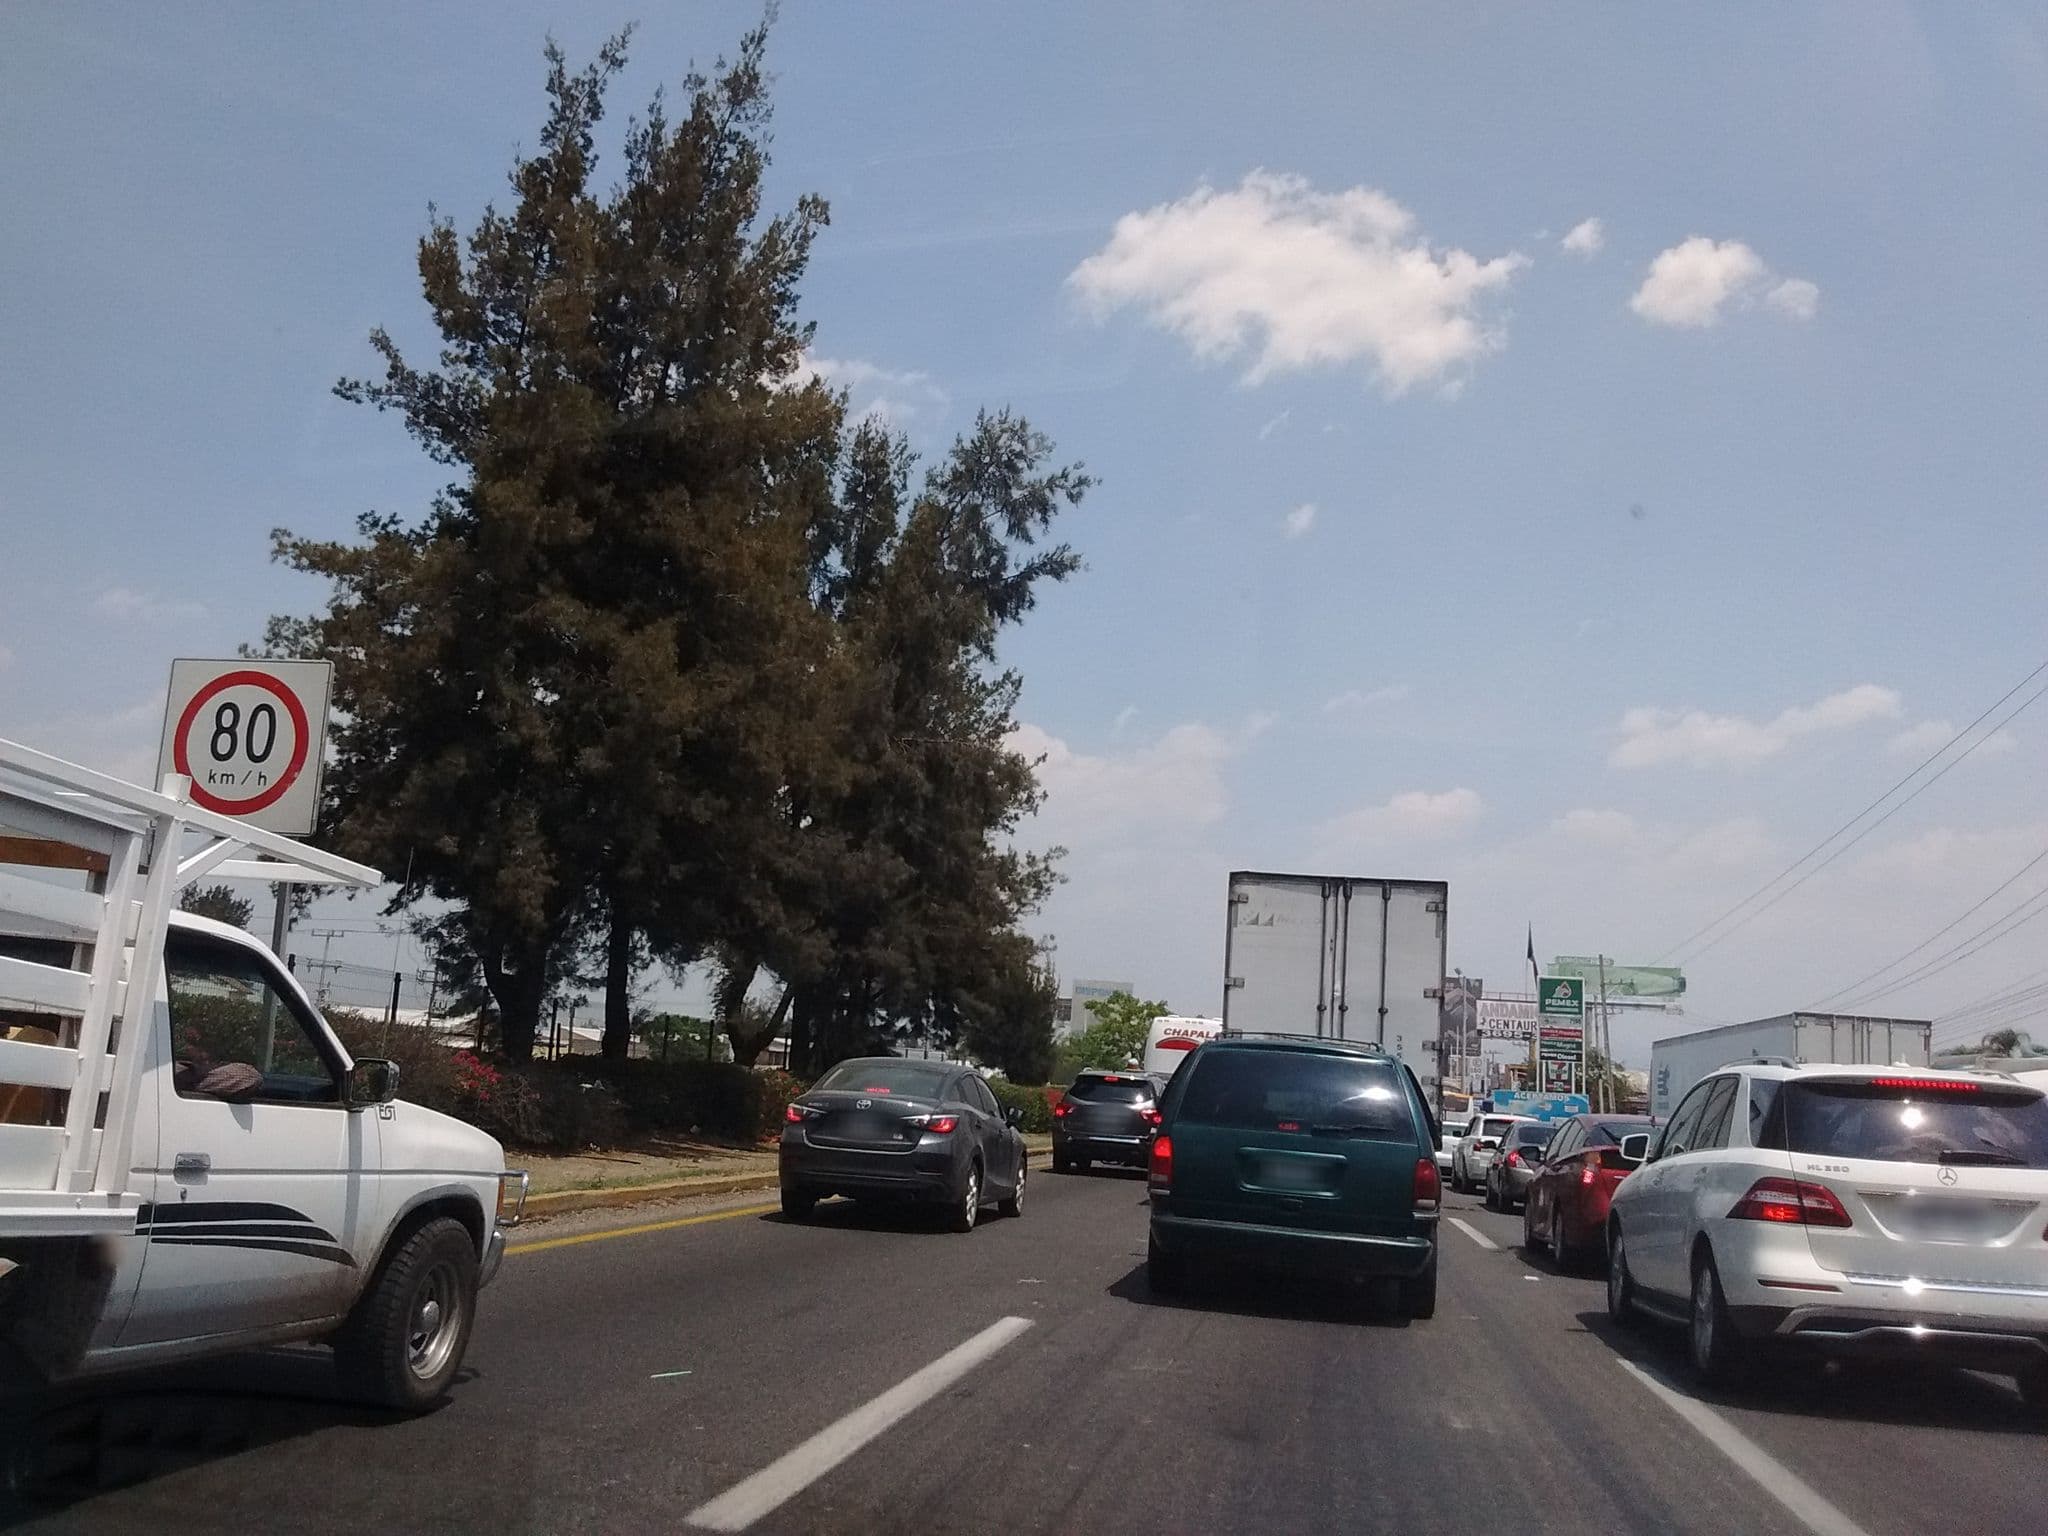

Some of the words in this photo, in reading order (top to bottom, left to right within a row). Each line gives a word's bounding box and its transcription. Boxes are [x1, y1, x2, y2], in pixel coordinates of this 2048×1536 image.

[210, 702, 277, 764] 80
[207, 768, 268, 787] km/h
[1545, 998, 1579, 1007] PEMEX
